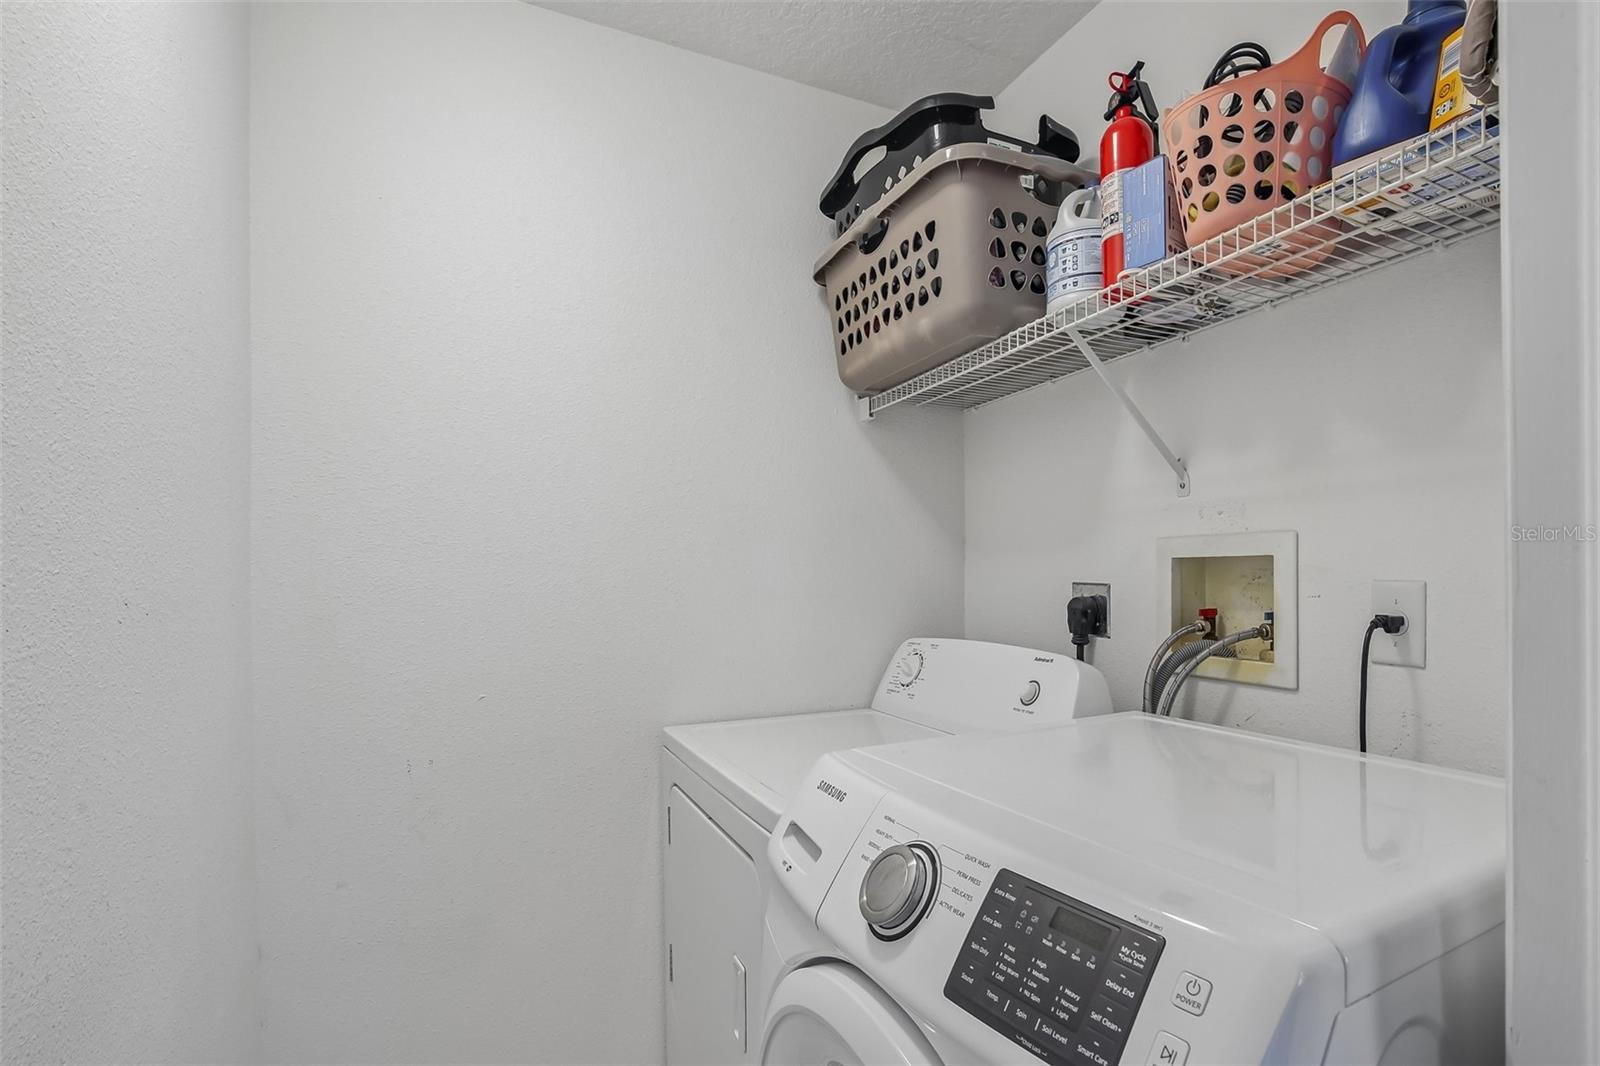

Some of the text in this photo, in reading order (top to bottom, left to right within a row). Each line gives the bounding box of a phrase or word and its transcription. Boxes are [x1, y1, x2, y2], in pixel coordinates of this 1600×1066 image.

[817, 780, 847, 802] SAMSUNG
[965, 853, 991, 869] QUICK WASH
[968, 875, 982, 887] PRESS
[951, 886, 974, 902] DELICATES
[939, 900, 966, 919] ACTIVE WEAR
[1120, 945, 1147, 963] My Cycle
[1036, 959, 1047, 969] High
[1086, 961, 1096, 970] End
[1027, 979, 1038, 988] Low
[1032, 969, 1050, 983] Medium
[986, 989, 999, 1003] Temp
[1064, 988, 1081, 1002] Heavy
[1105, 979, 1135, 999] Delay End
[1060, 998, 1079, 1013] Normal
[1175, 993, 1202, 1010] POWER
[1015, 1008, 1028, 1020] Spin
[1056, 1009, 1069, 1021] Light
[1090, 1011, 1118, 1032] Self Clean
[1041, 1024, 1068, 1045] Soil Level
[1077, 1044, 1108, 1066] Smart Care
